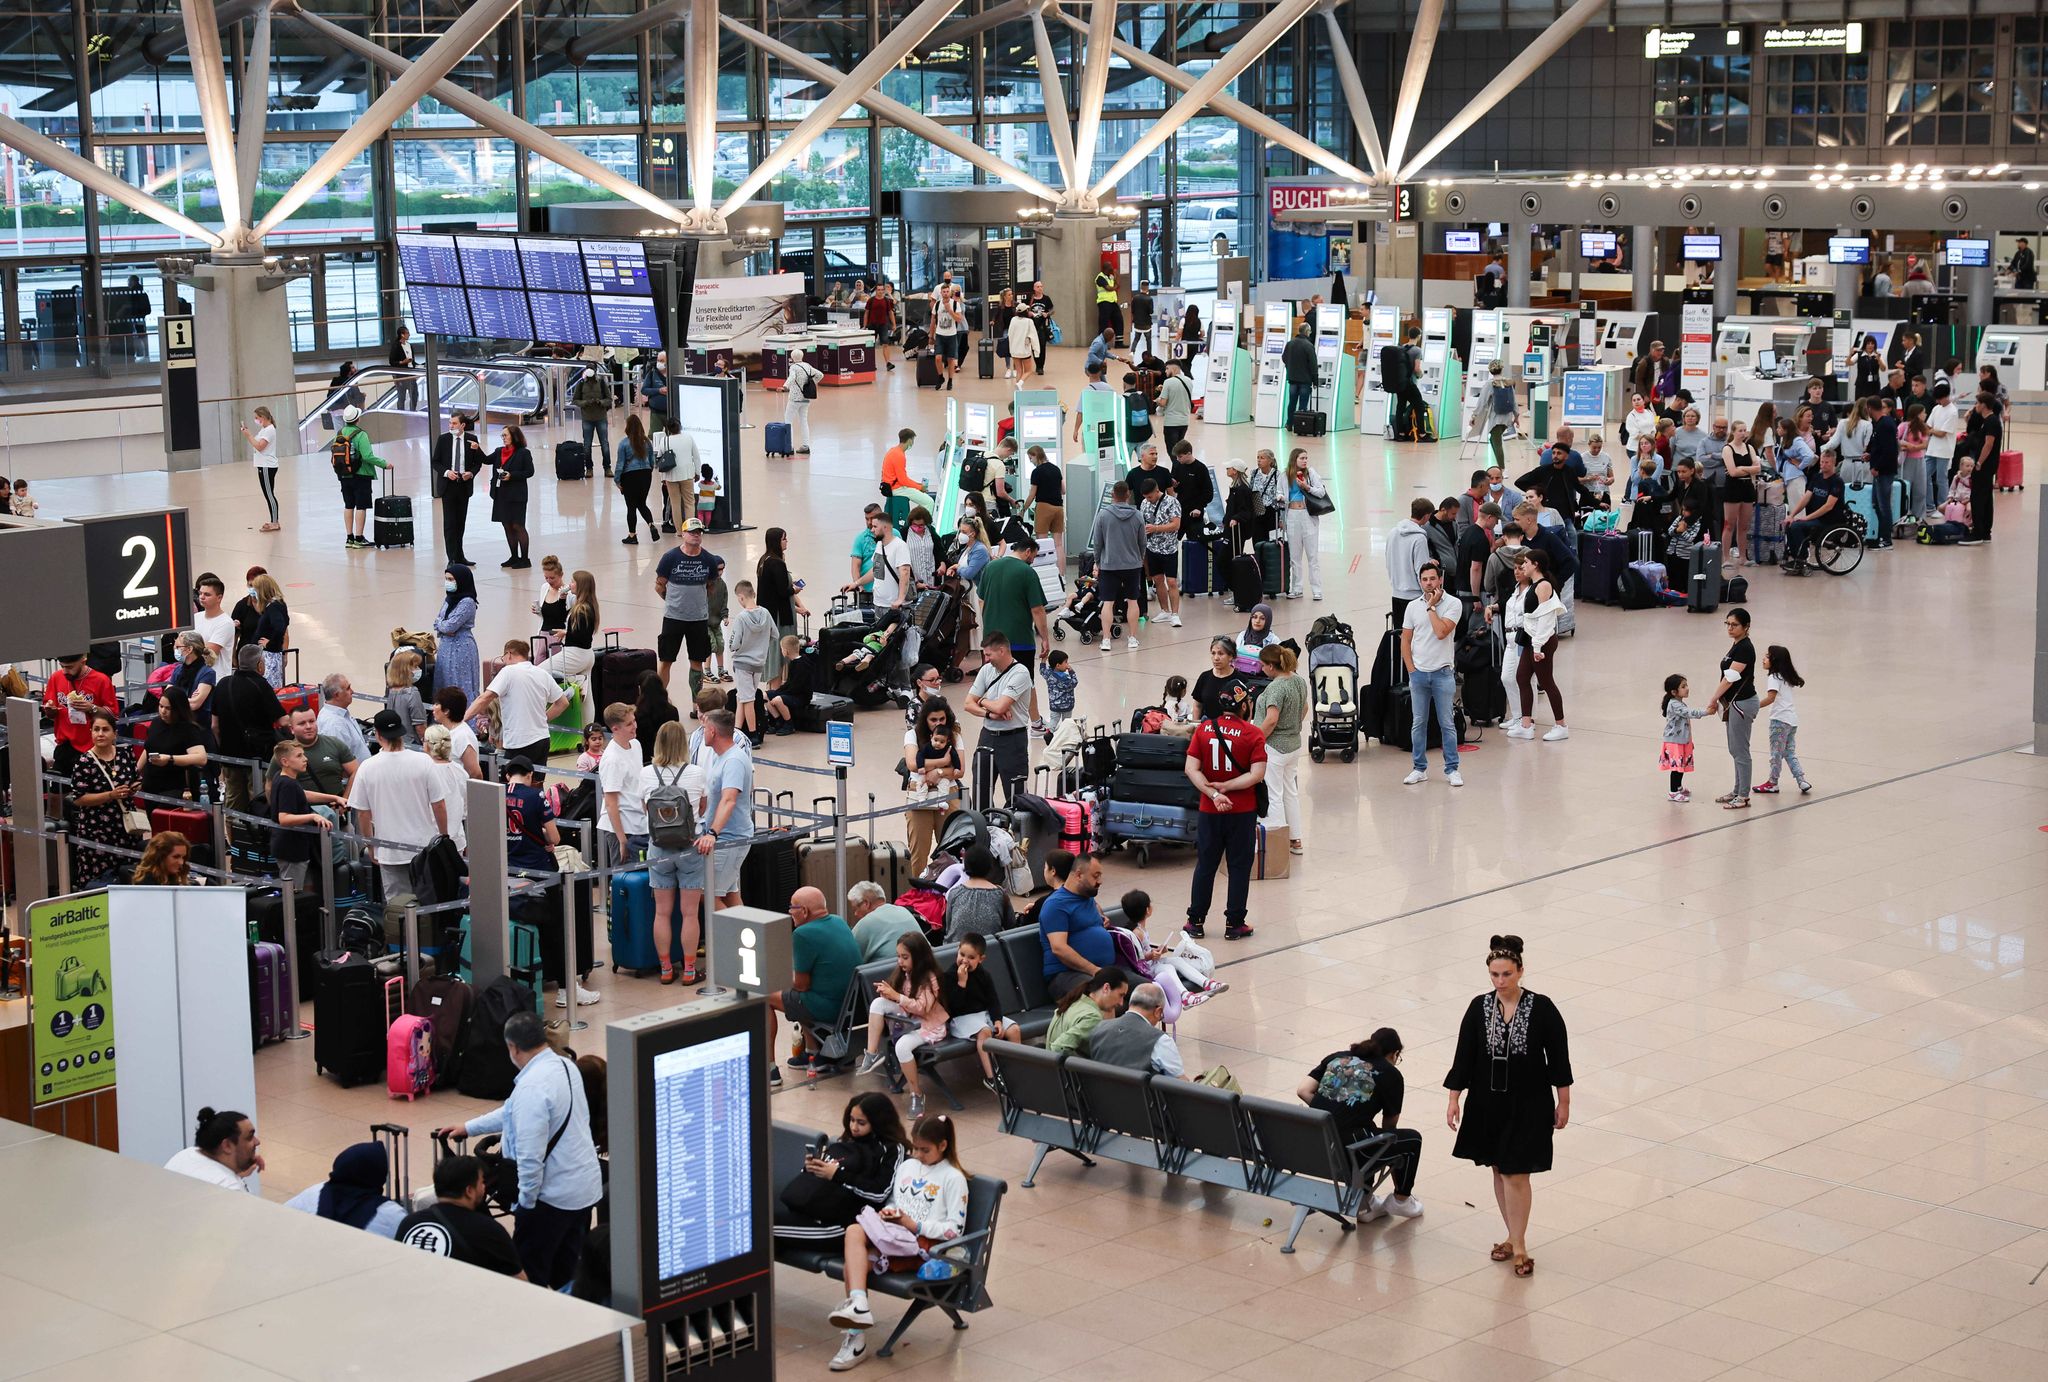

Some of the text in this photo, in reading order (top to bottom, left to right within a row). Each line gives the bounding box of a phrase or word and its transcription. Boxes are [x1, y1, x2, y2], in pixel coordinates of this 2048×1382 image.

[1399, 190, 1410, 211] 3
[695, 304, 756, 314] Unsere Kreditkarten
[705, 314, 730, 322] Flexible
[730, 313, 742, 321] und
[121, 535, 159, 599] 2
[115, 605, 160, 620] Check-in
[1208, 738, 1233, 771] 11
[49, 905, 101, 928] airBaltic
[58, 1012, 66, 1025] 1
[89, 1005, 97, 1018] 1
